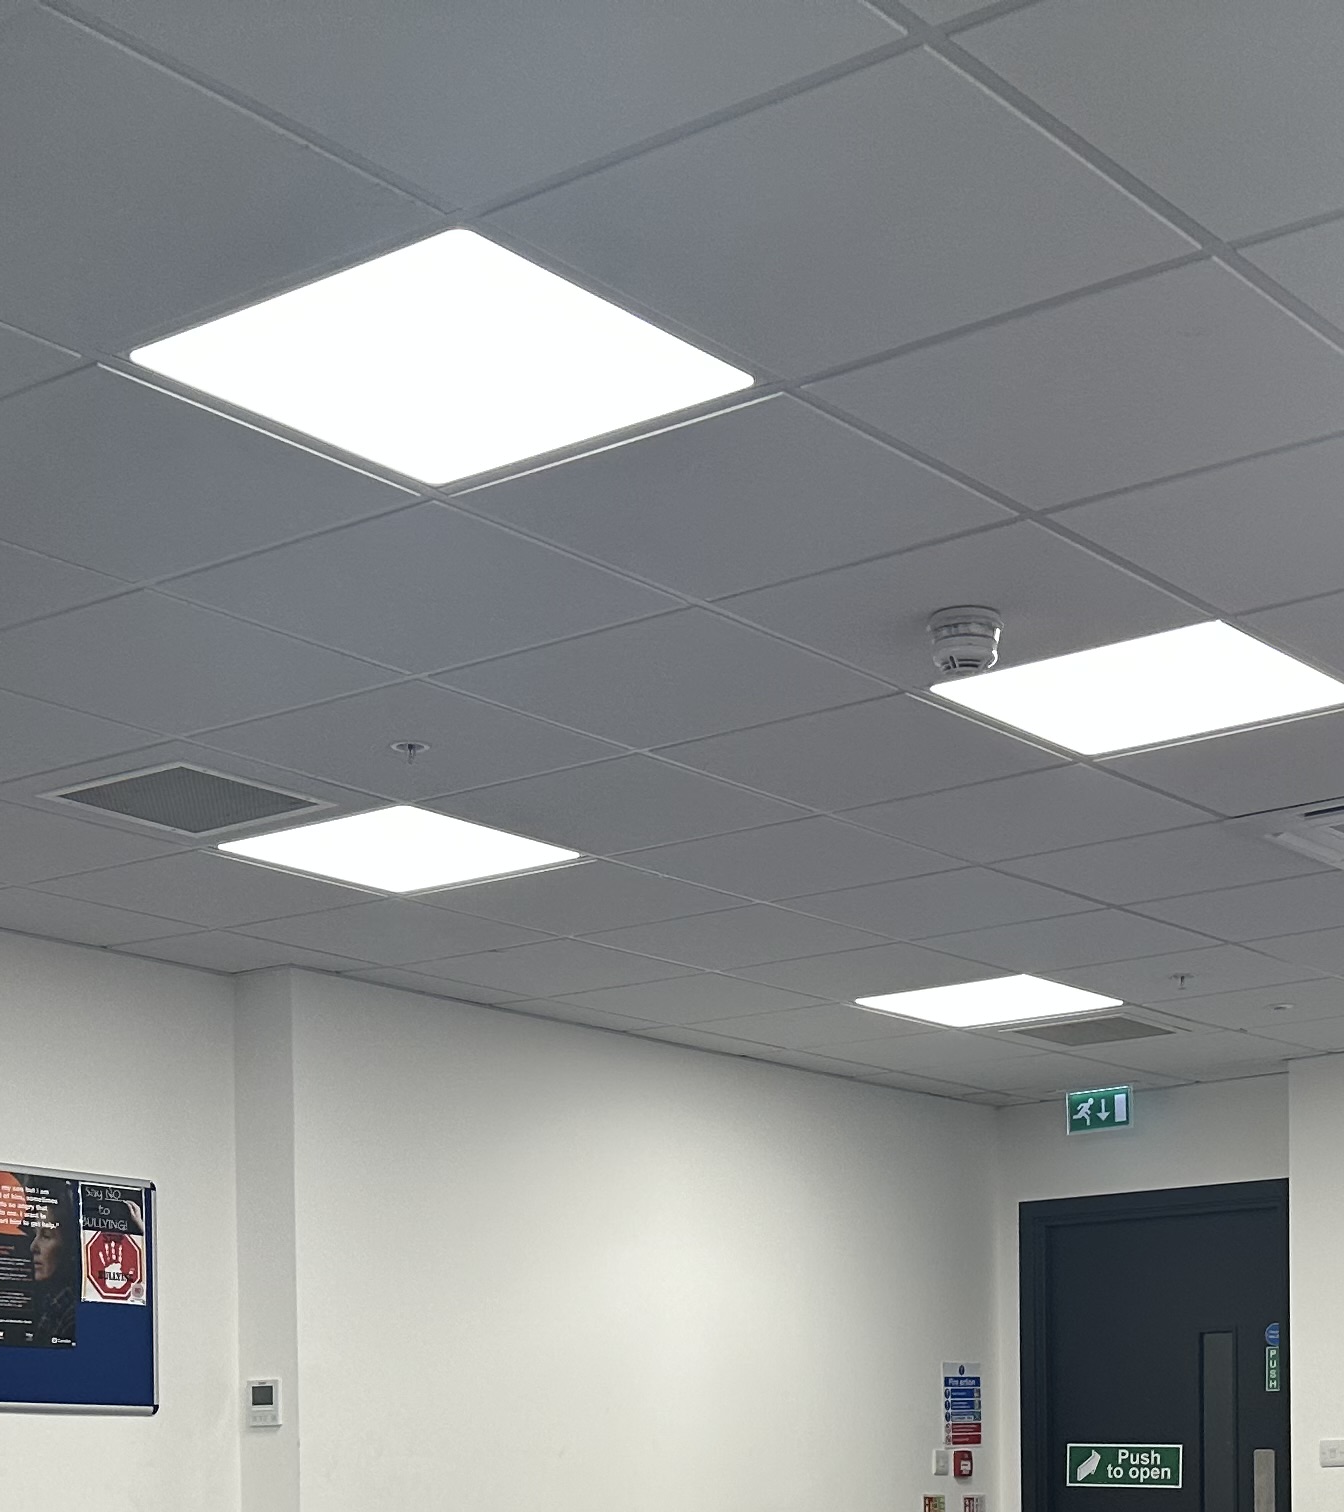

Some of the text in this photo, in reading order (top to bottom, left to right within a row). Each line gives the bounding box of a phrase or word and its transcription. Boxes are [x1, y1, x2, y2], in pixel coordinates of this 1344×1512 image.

[26, 1196, 58, 1204] sometimes
[85, 1187, 121, 1200] Say NO
[98, 1205, 111, 1215] to
[1118, 1449, 1160, 1465] Push
[1107, 1464, 1171, 1482] to open
